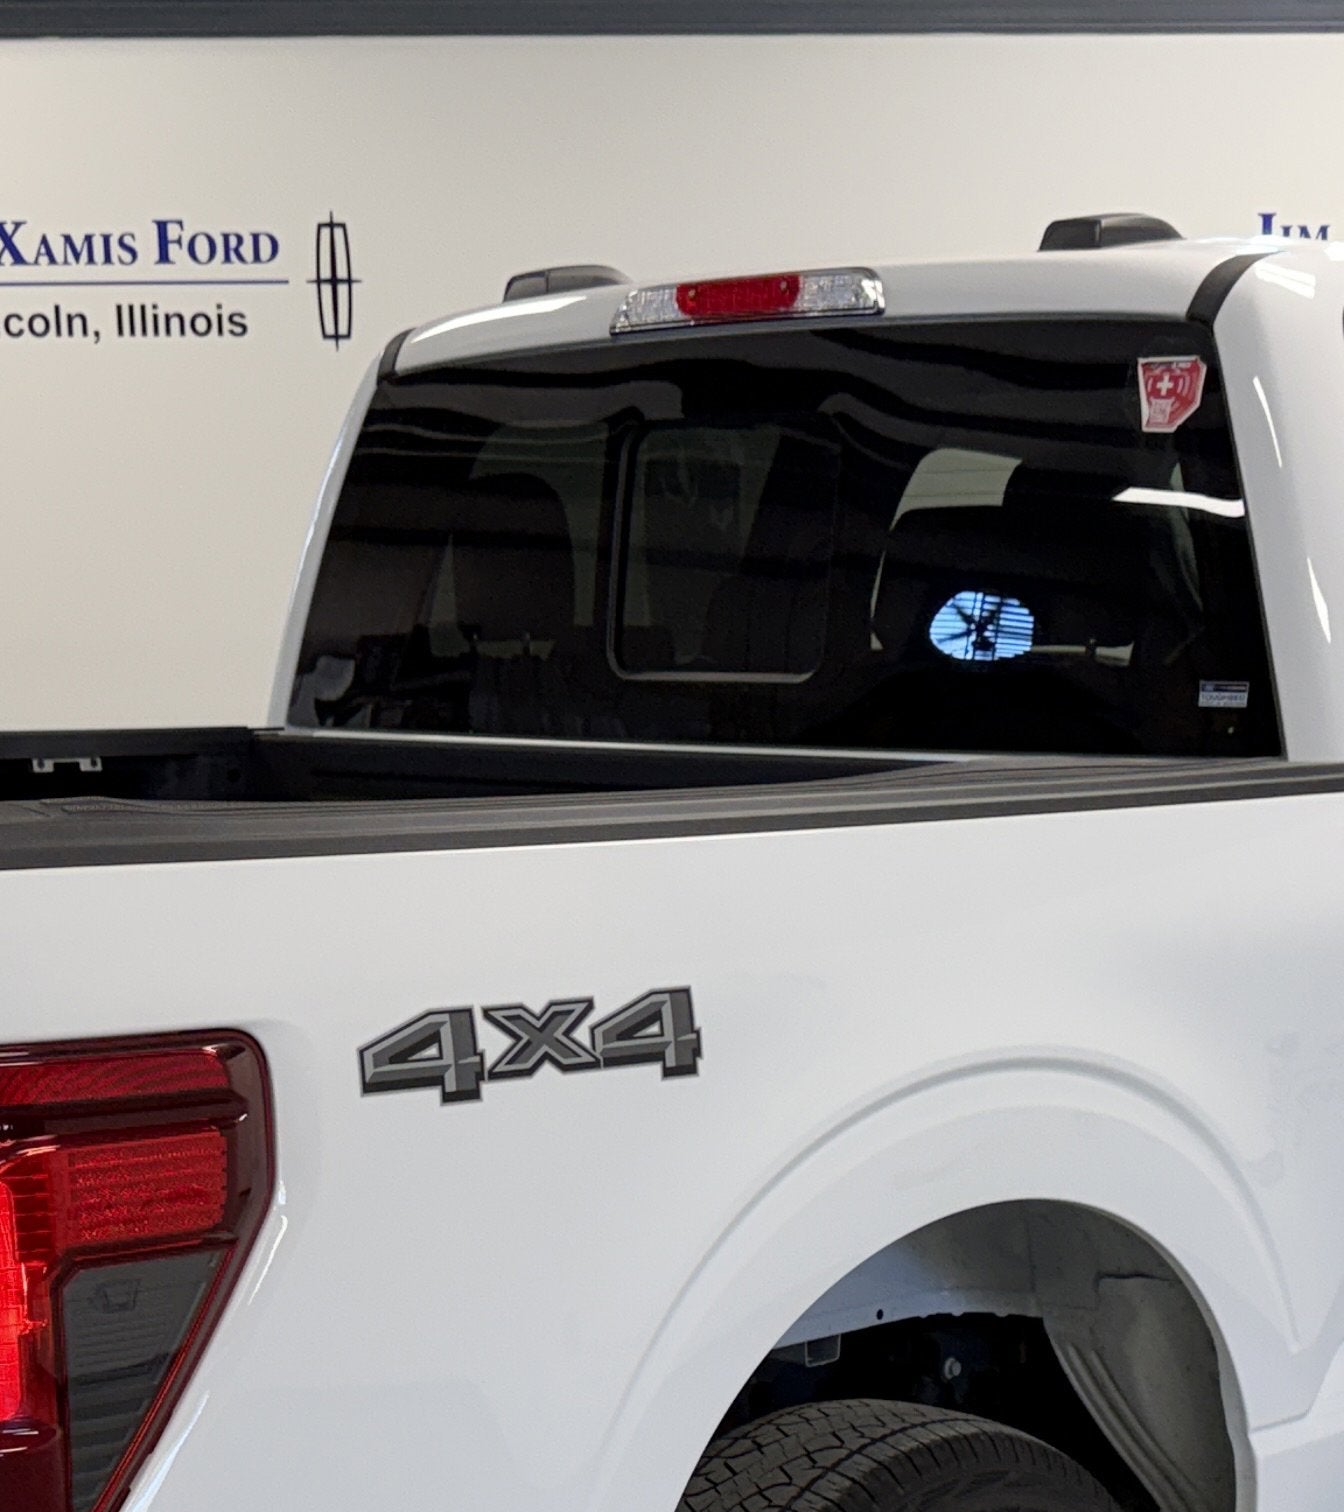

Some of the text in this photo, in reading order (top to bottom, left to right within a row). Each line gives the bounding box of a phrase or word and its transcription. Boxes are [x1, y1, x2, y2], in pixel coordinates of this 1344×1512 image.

[151, 219, 280, 265] FORD
[114, 303, 249, 338] Illinois
[357, 986, 702, 1107] 4X4
